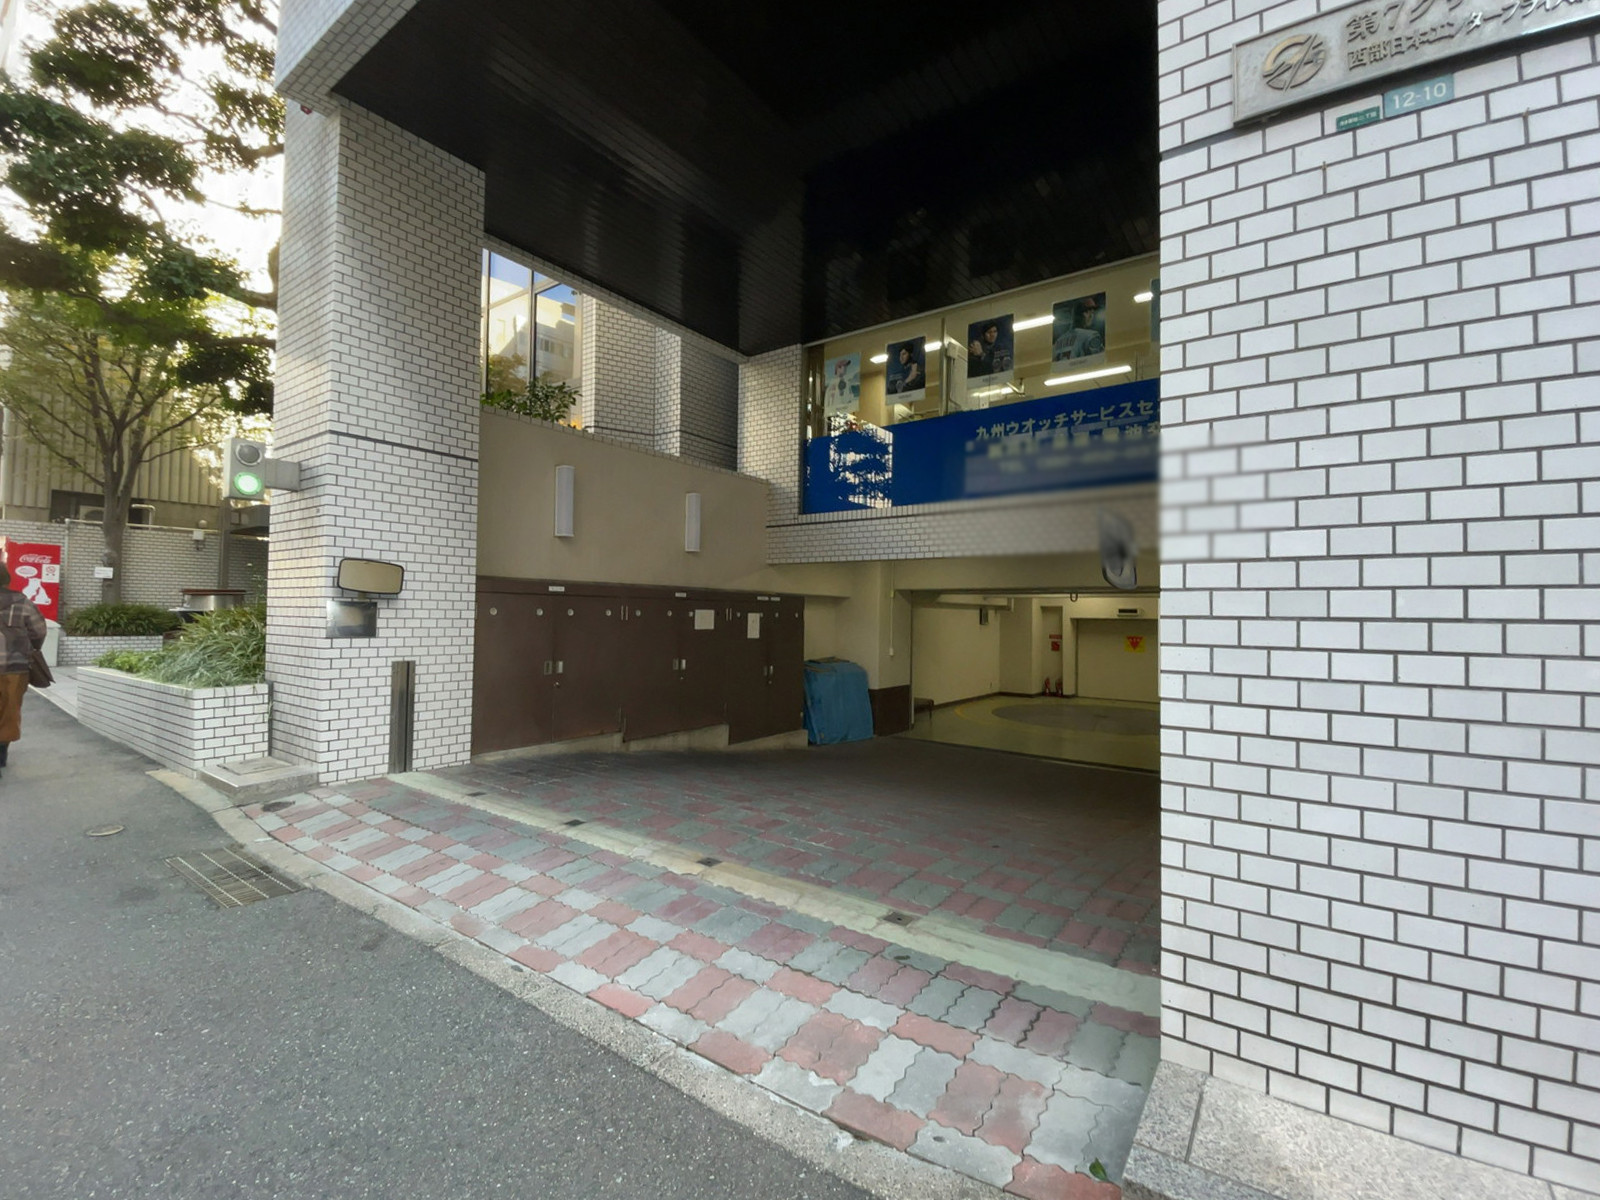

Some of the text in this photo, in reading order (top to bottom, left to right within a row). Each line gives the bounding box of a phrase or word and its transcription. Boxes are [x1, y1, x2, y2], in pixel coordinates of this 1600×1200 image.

[1393, 82, 1447, 109] 12-10
[976, 400, 1161, 440] 九州ウオッチサービスセ
